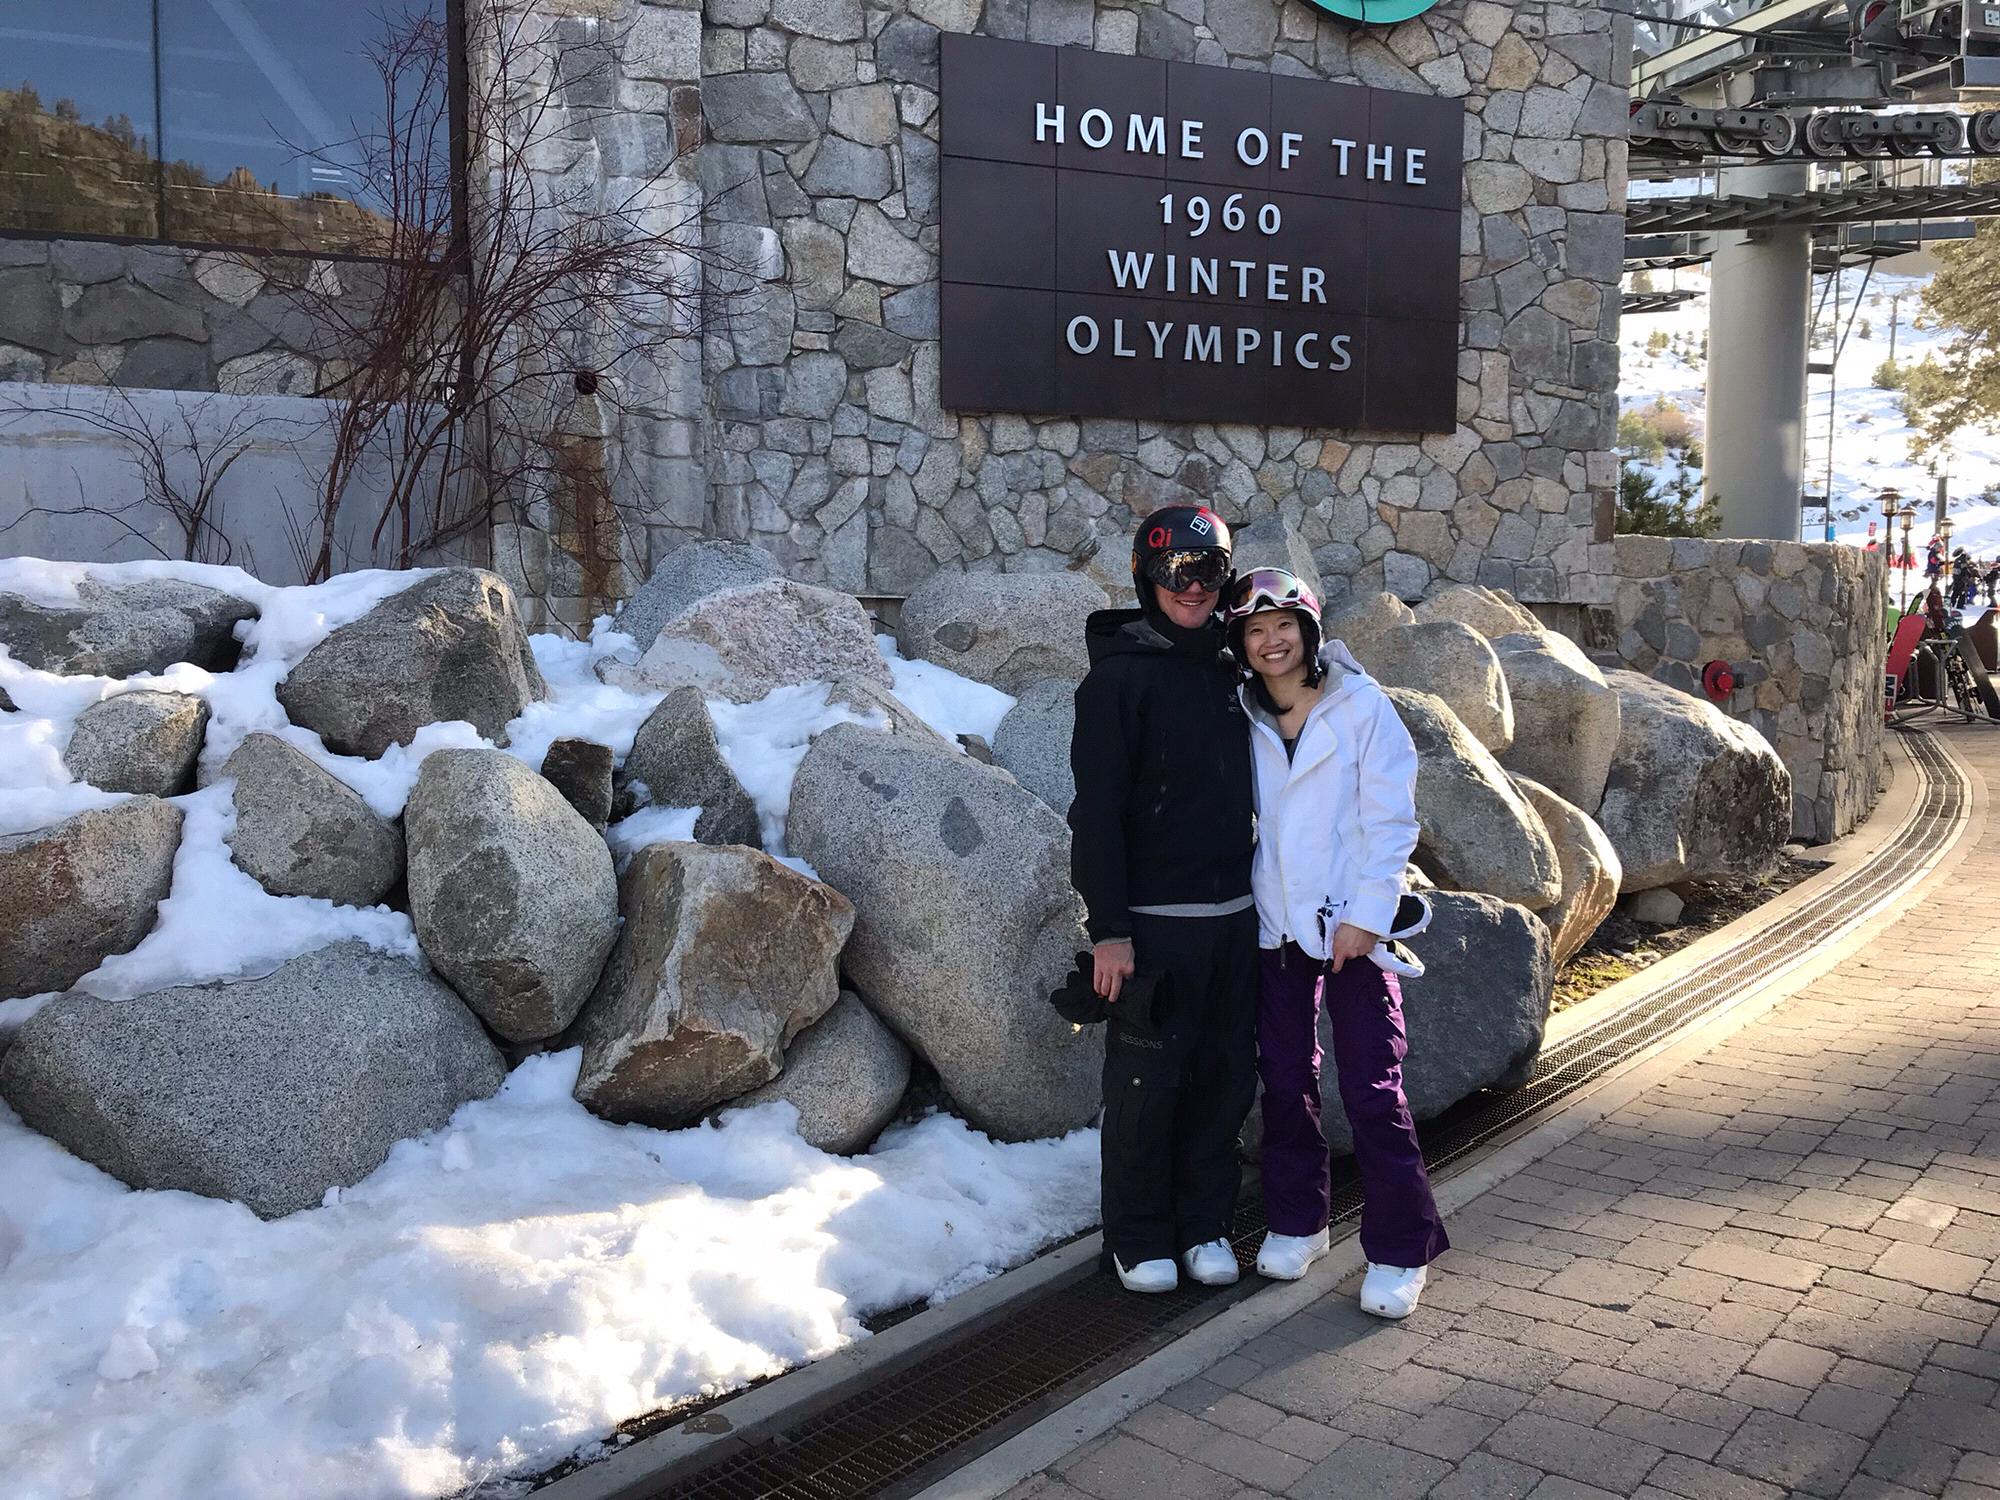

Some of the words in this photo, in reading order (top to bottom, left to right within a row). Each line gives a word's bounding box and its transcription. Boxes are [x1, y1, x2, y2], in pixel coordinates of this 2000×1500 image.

[1036, 102, 1204, 159] HOME
[1236, 127, 1303, 169] OF
[1331, 138, 1427, 185] THE
[1159, 192, 1282, 237] 1960
[1107, 249, 1327, 304] WINTER
[1066, 315, 1352, 371] OLYMPICS
[1148, 527, 1172, 548] Qi
[1119, 1031, 1164, 1049] SESSIONS
